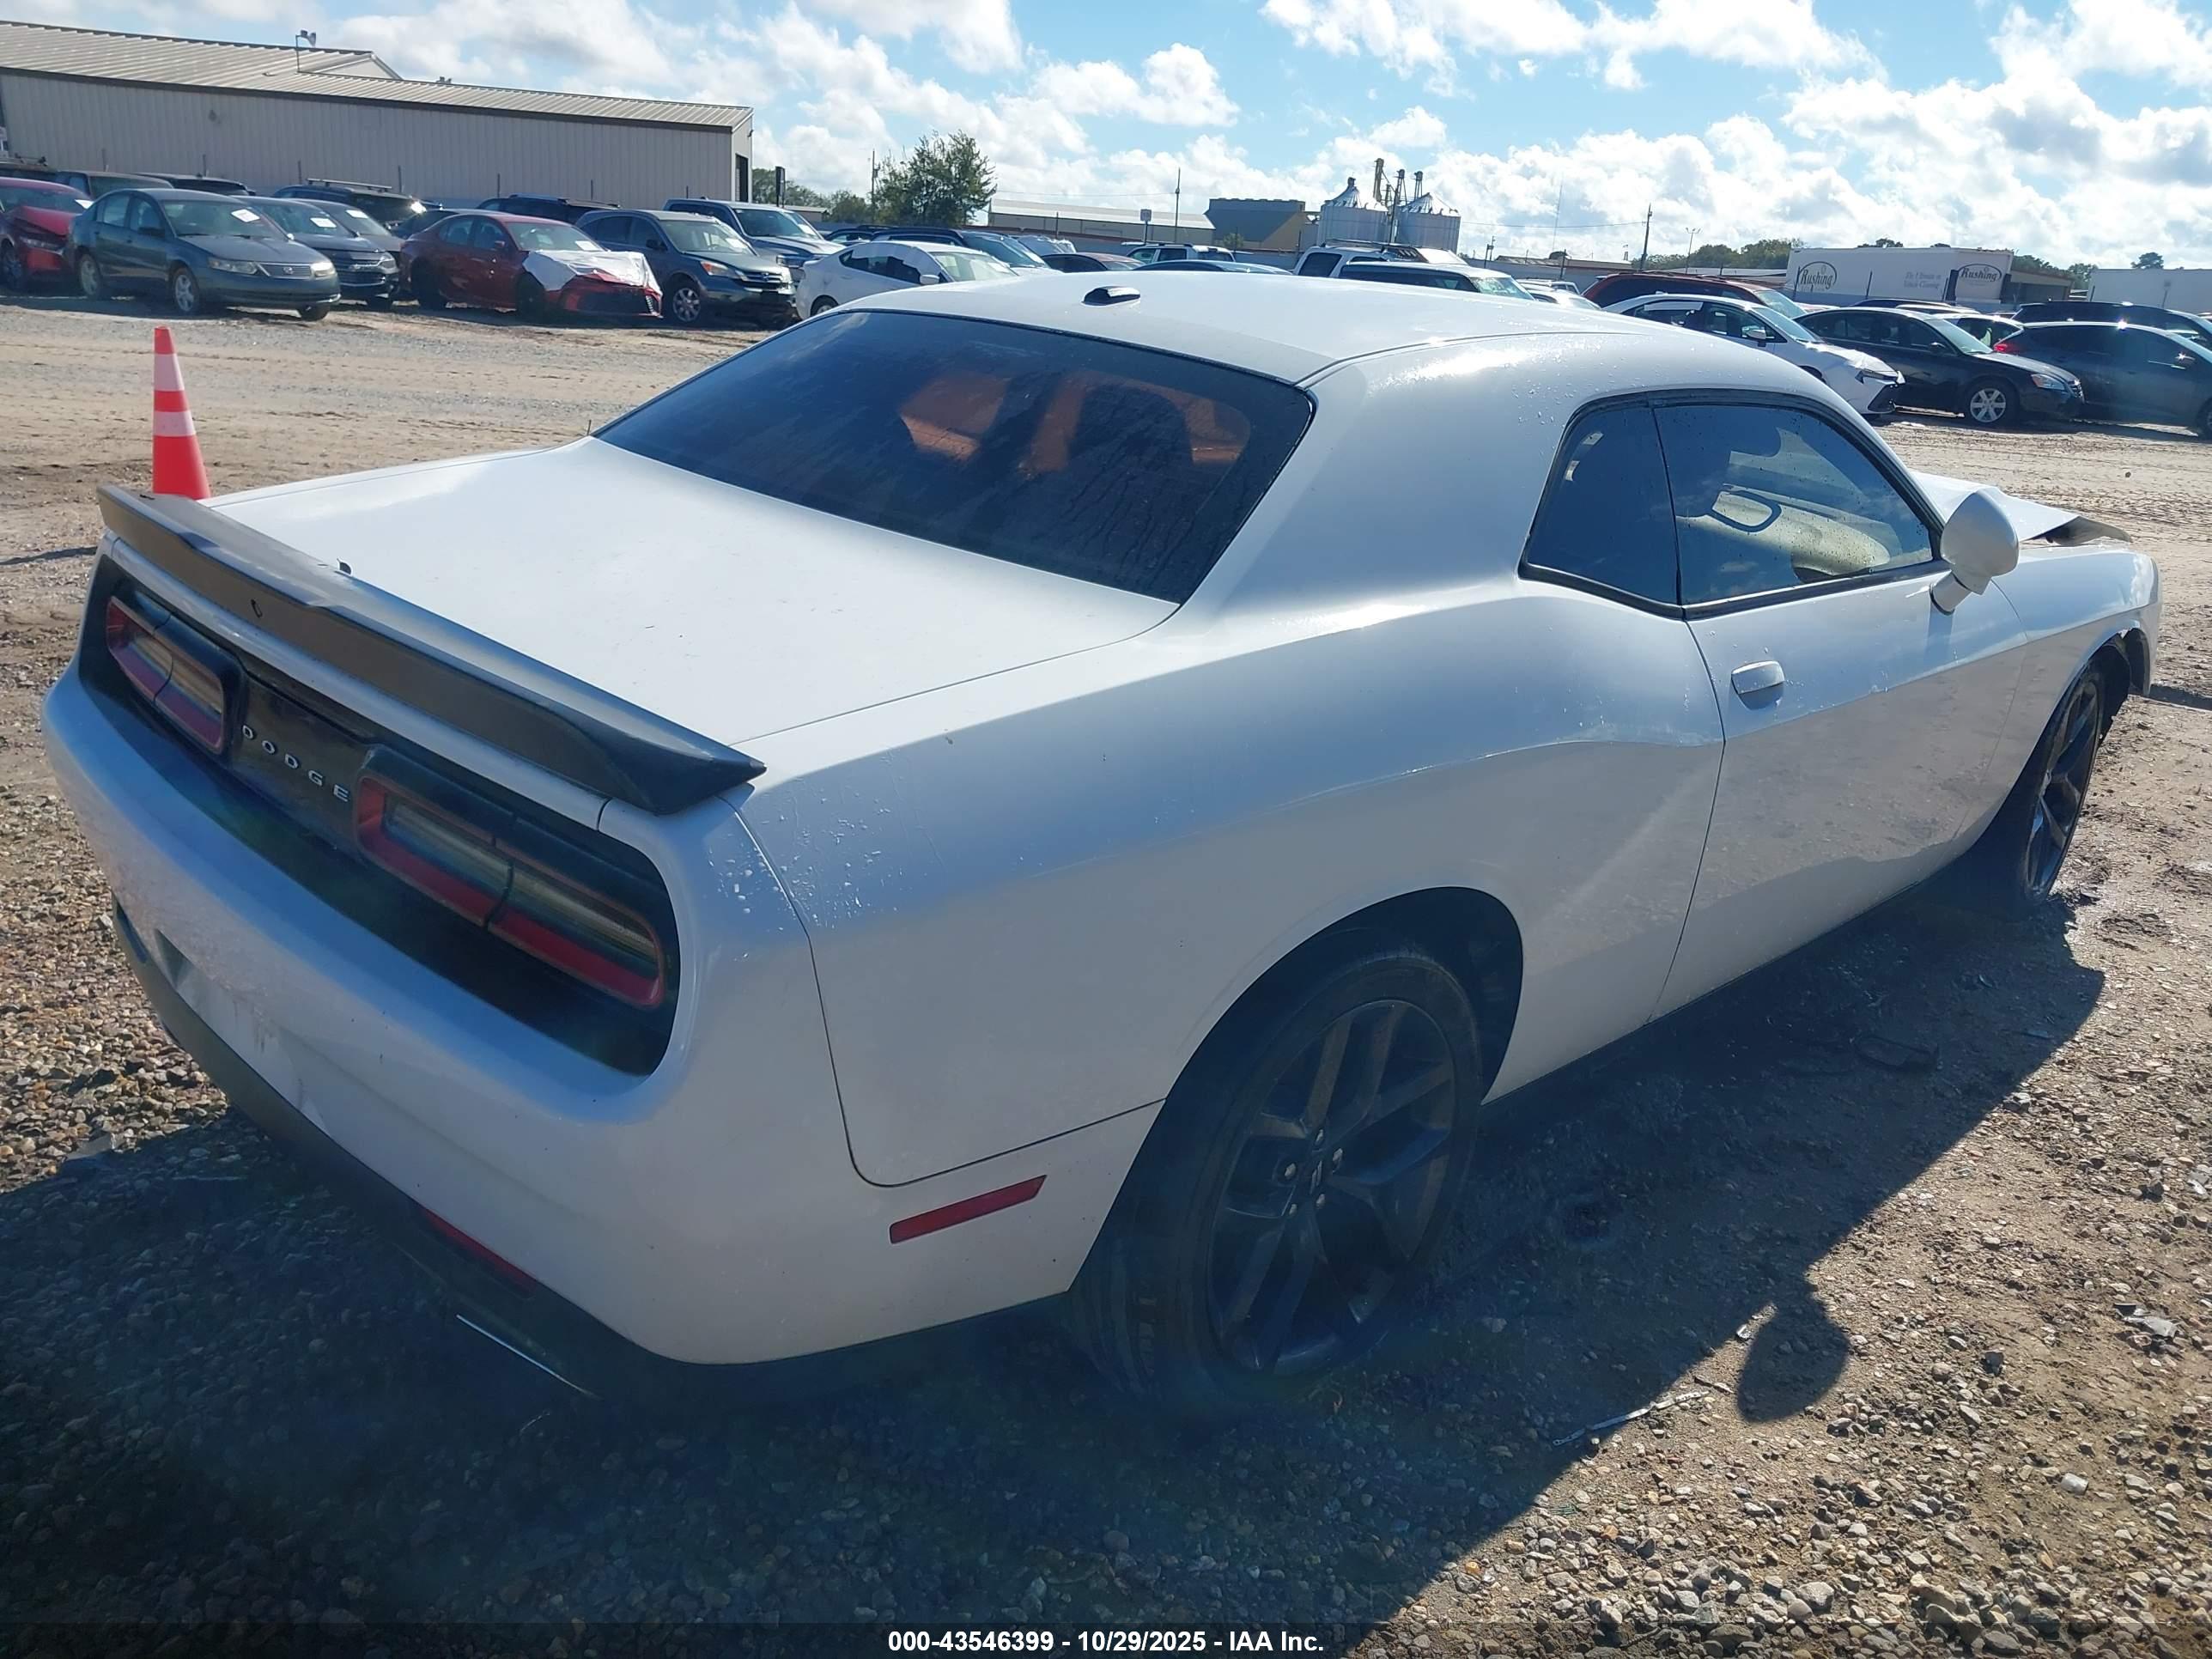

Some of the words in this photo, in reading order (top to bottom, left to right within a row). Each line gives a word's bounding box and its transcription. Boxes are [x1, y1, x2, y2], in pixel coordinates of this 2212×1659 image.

[1800, 269, 1833, 289] Rushing
[1961, 267, 1998, 283] Rushing
[241, 724, 349, 803] DODGE
